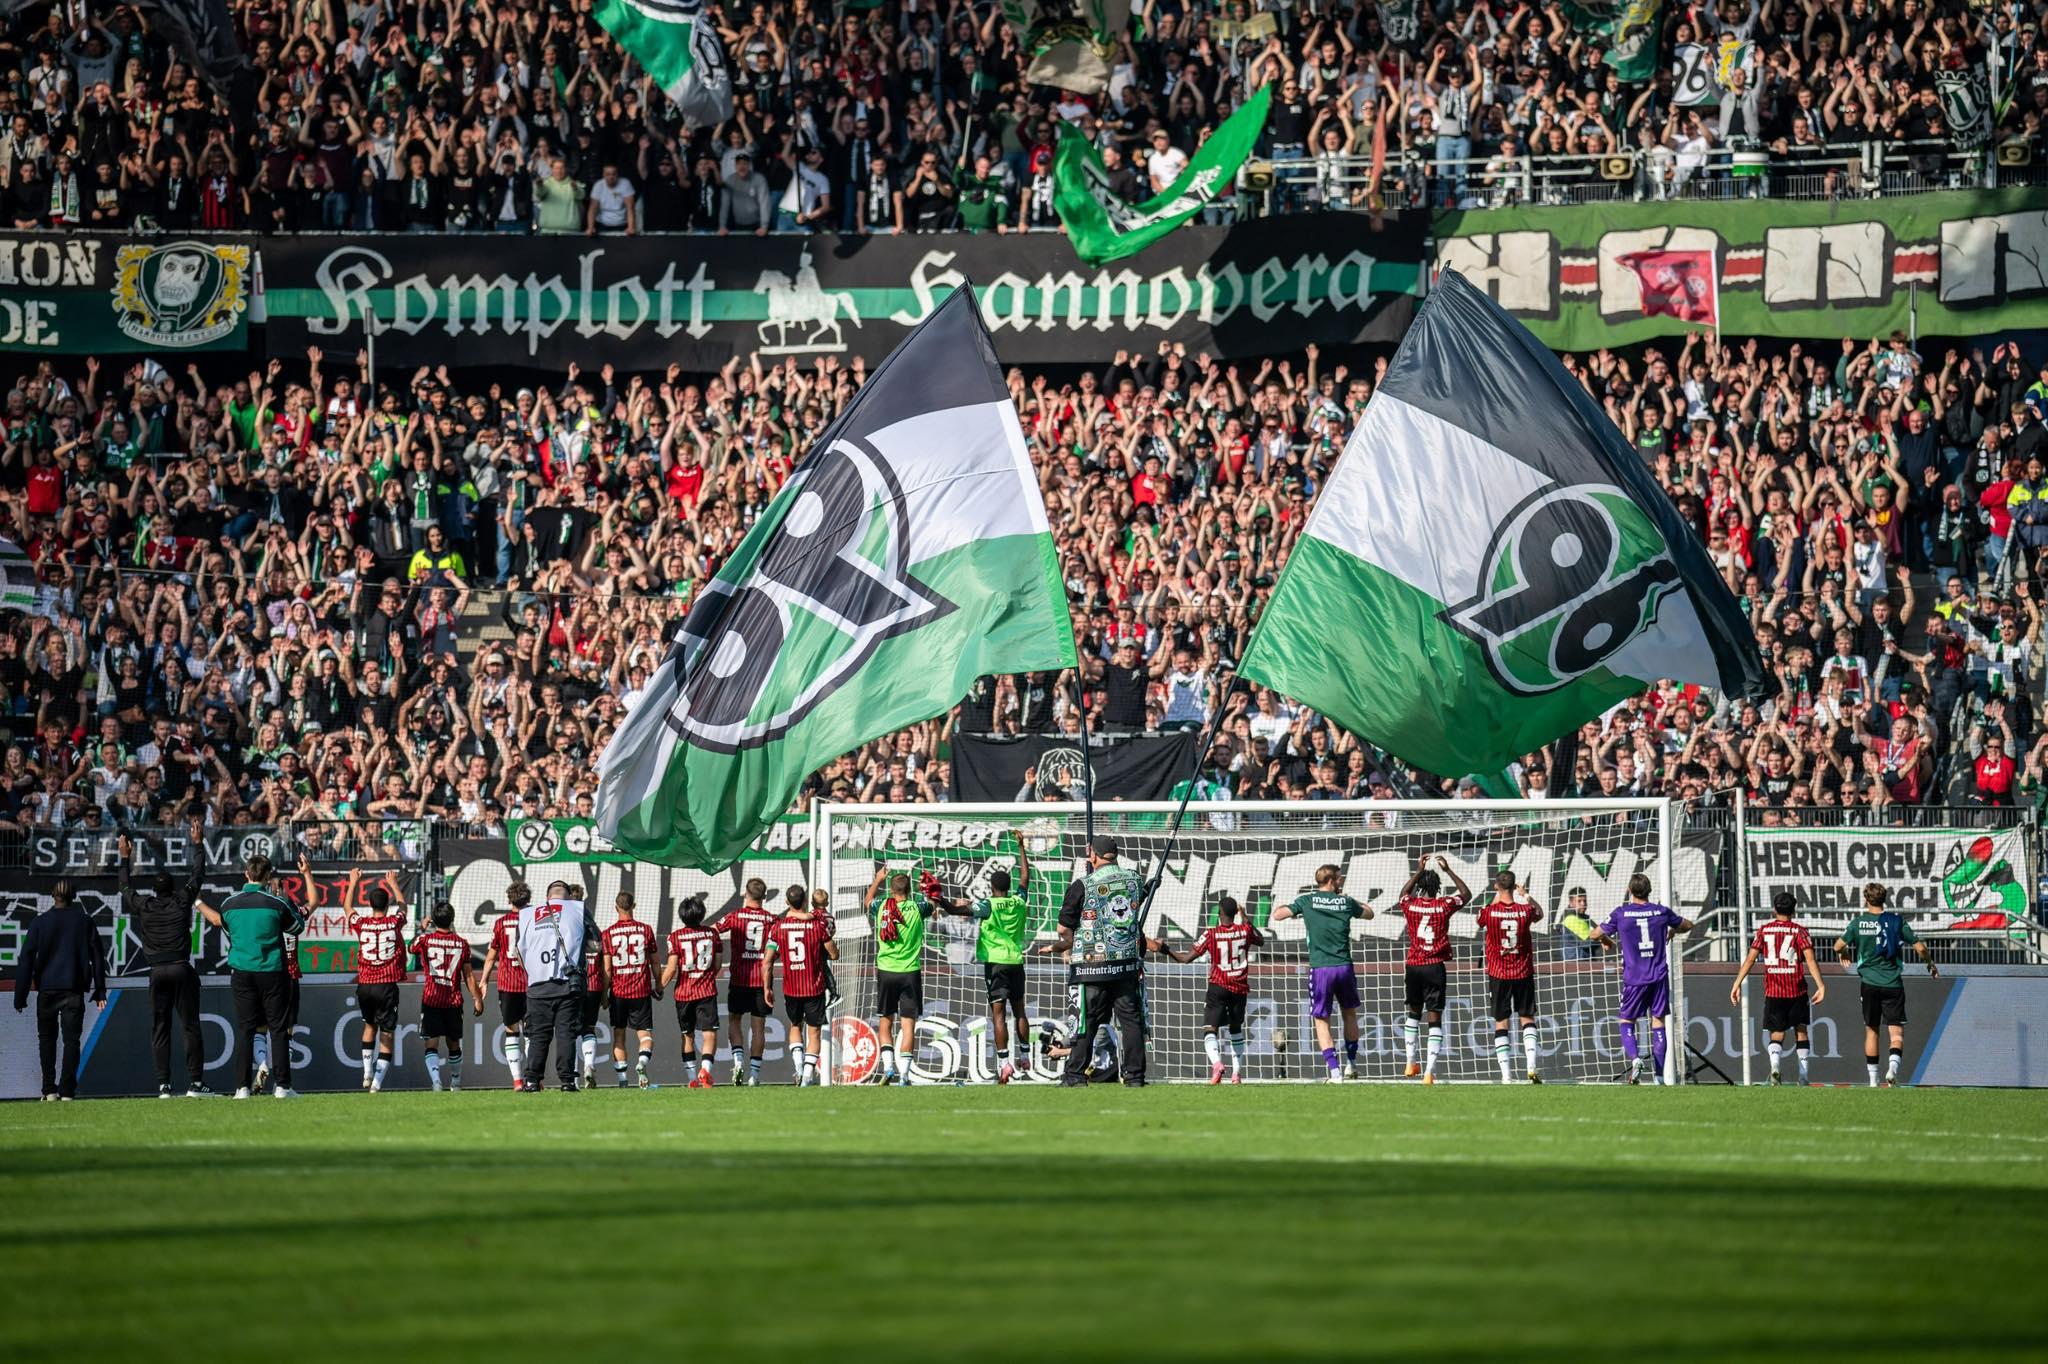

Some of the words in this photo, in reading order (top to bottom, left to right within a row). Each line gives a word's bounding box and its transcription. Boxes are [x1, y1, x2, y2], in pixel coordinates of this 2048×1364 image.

[306, 245, 715, 356] Komplott
[35, 837, 233, 867] SEHLEM
[522, 821, 556, 858] 96
[1749, 841, 1840, 877] HERRI
[1846, 841, 1936, 879] CREW
[1312, 896, 1346, 904] macron
[745, 921, 764, 950] 9
[1417, 915, 1435, 944] 4
[1501, 920, 1518, 949] 3
[1636, 918, 1654, 950] 1
[361, 931, 397, 961] 26
[612, 934, 645, 966] 33
[681, 939, 714, 971] 18
[788, 931, 806, 962] 5
[1217, 940, 1248, 971] 15
[1764, 934, 1798, 966] 14
[428, 947, 463, 978] 27
